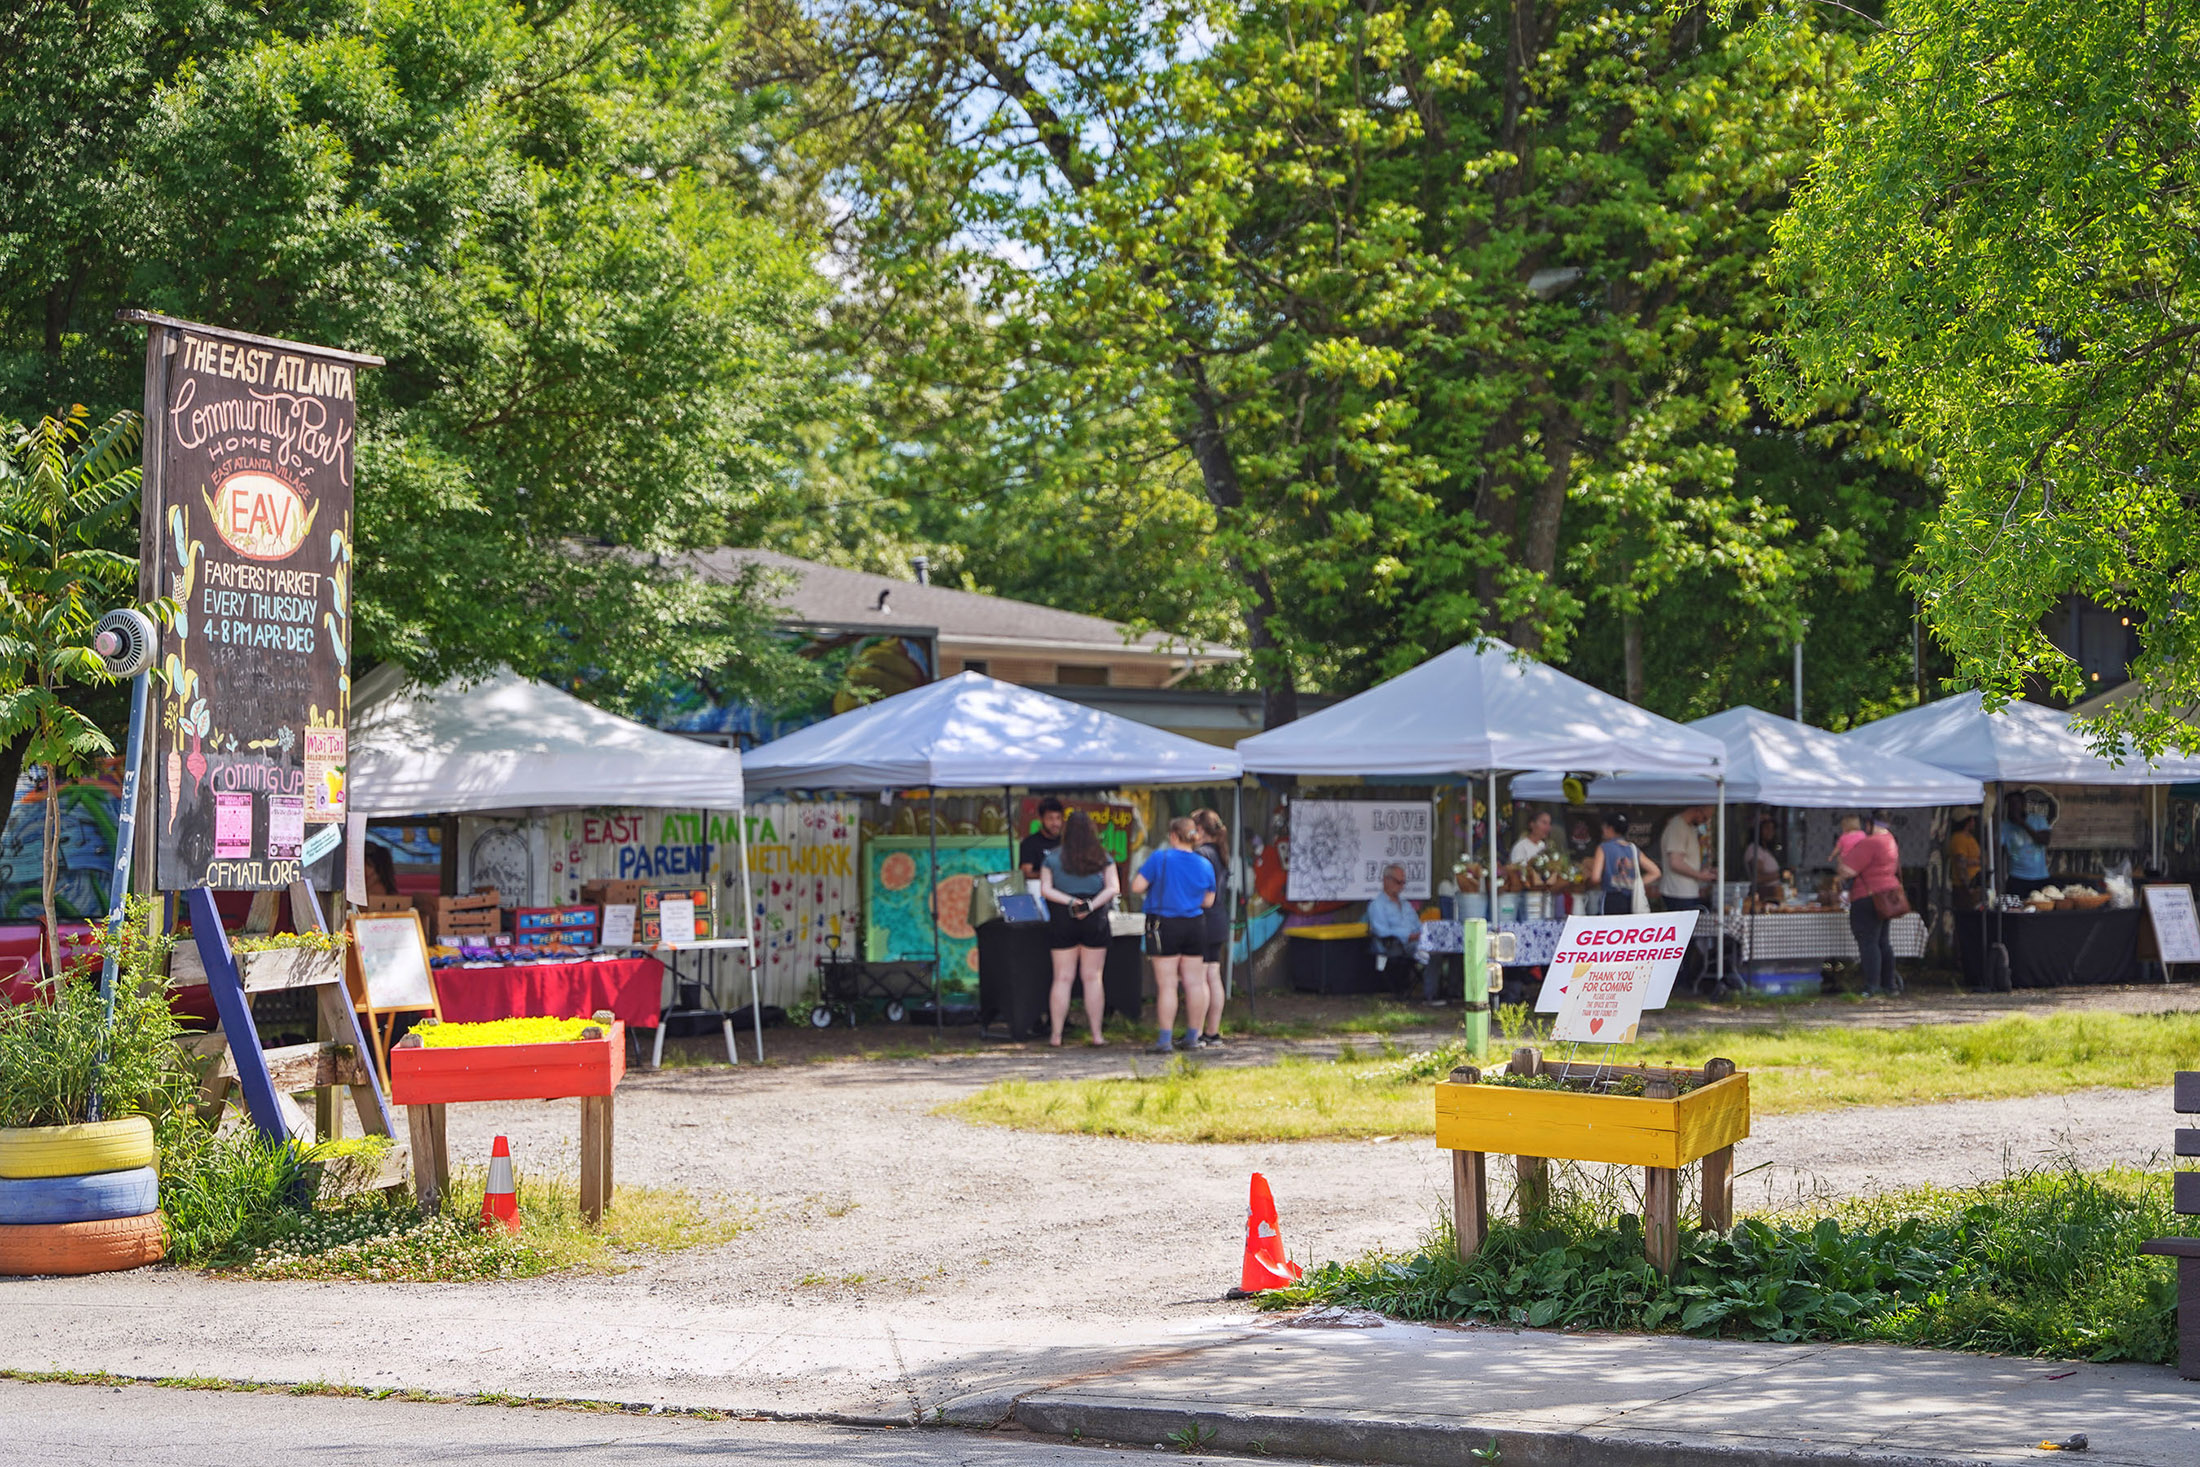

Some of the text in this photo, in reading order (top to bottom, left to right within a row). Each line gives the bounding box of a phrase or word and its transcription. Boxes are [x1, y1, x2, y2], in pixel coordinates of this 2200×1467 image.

[183, 336, 354, 402] THE EAST ATLANTA
[170, 378, 352, 486] Community Park
[209, 437, 272, 462] HOME
[210, 457, 311, 500] EAST ATLANTA VILLAGE
[232, 490, 292, 536] EAV
[204, 560, 321, 597] FARMERS MARKET
[203, 588, 318, 625] EVERY THURSDAY
[233, 622, 252, 646] PM
[253, 623, 315, 654] APR-DEC
[307, 735, 344, 753] Mai Tai
[584, 814, 778, 845] EAST ATLANTA
[1064, 806, 1132, 828] Snd-up
[1373, 809, 1427, 831] LOVE
[1386, 834, 1427, 857] JOY
[206, 860, 301, 888] CFMATL.ORG
[619, 844, 853, 879] PARENT NETWORK
[1366, 859, 1426, 882] FM
[1576, 926, 1677, 946] GEORGIA
[1555, 947, 1685, 964] STRAWBERRIES
[1582, 982, 1633, 992] FOR COMING
[1589, 970, 1635, 981] THANK YOU
